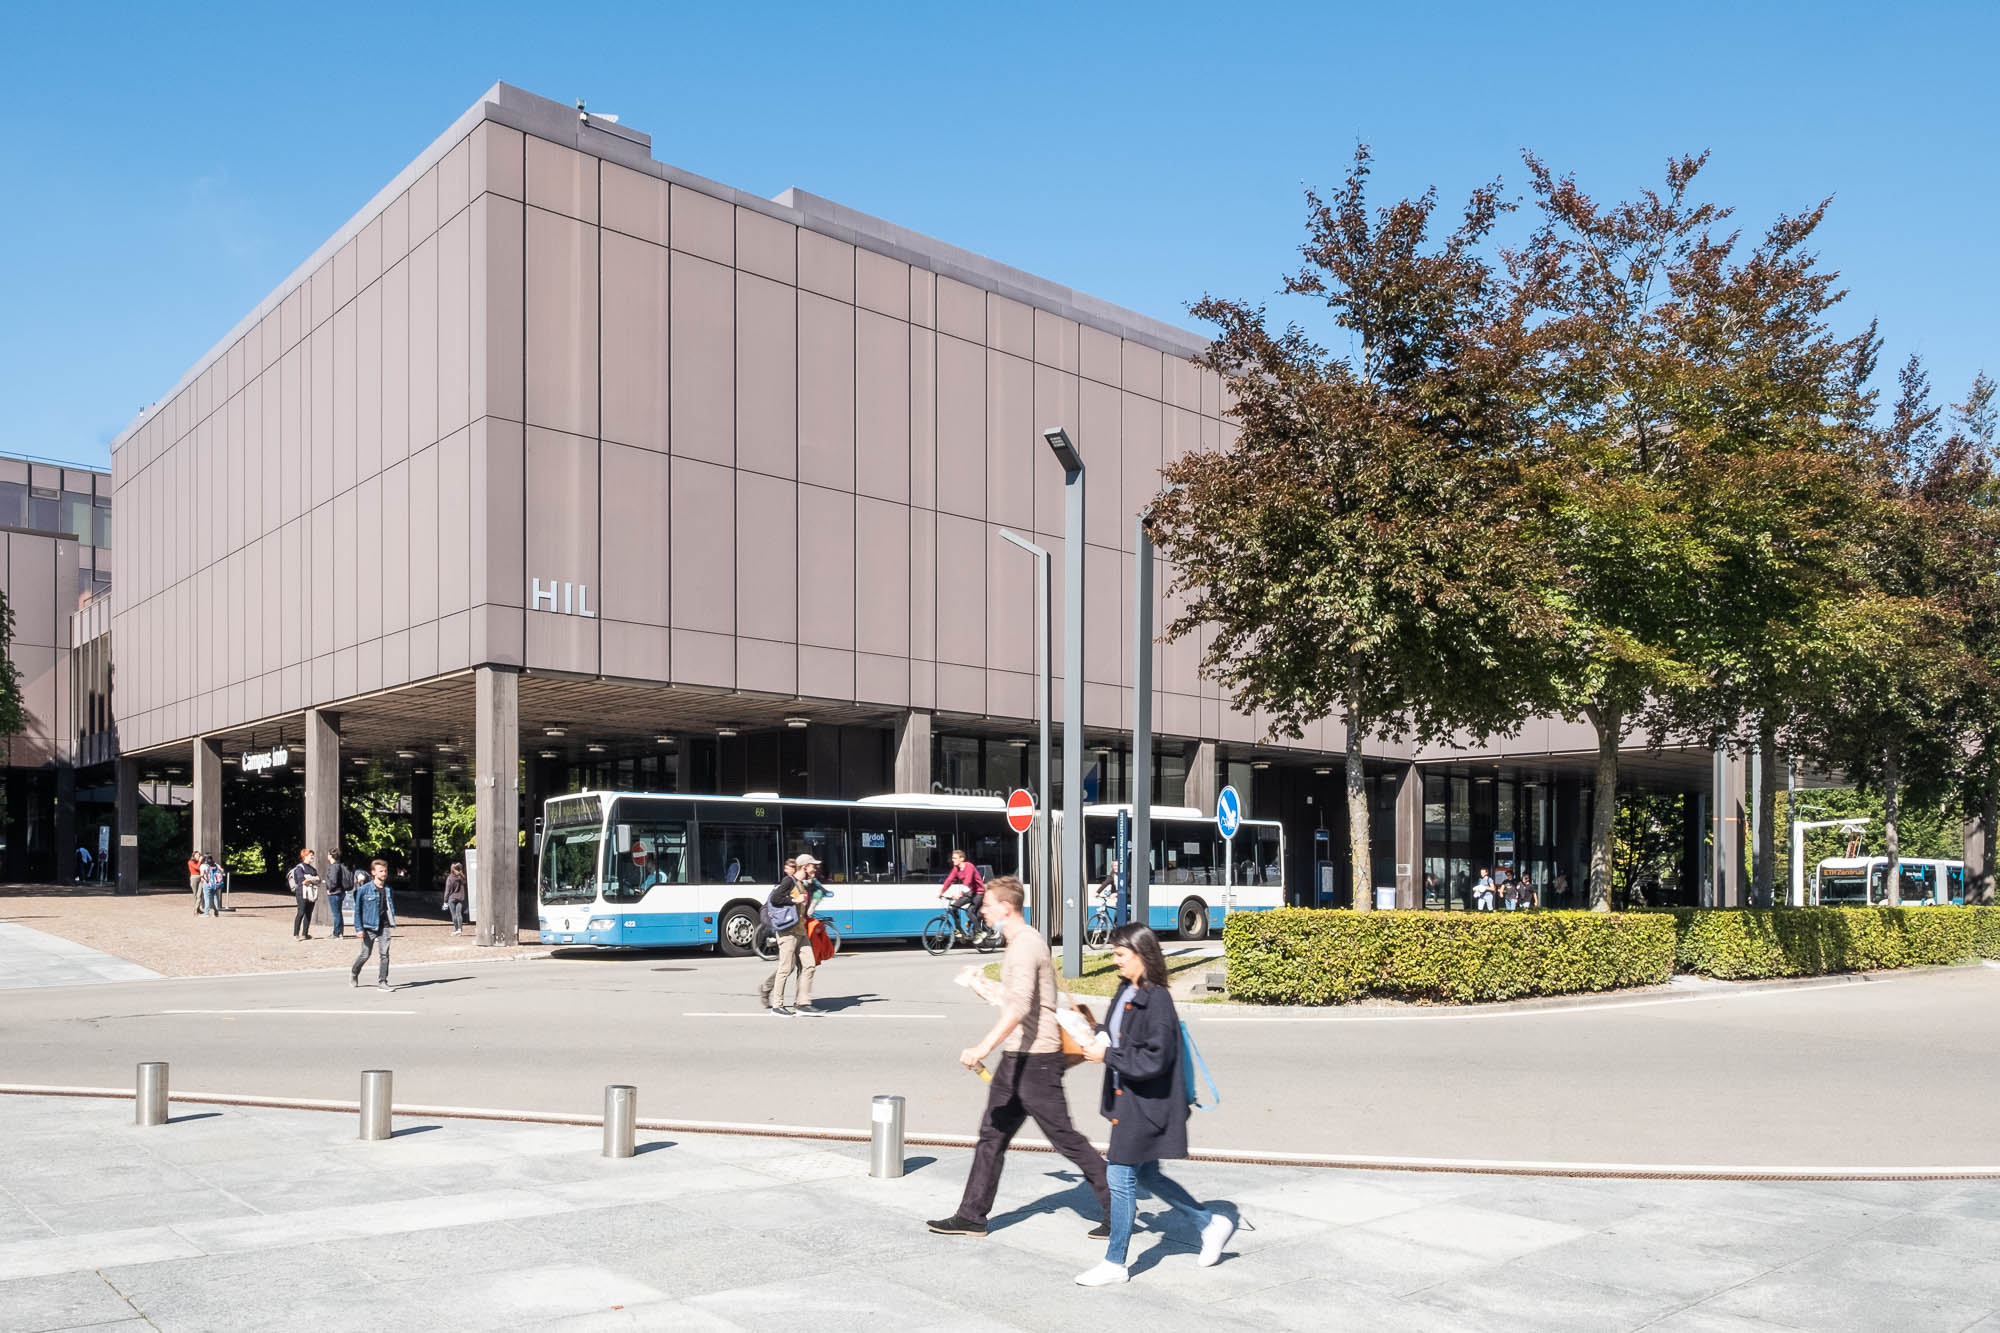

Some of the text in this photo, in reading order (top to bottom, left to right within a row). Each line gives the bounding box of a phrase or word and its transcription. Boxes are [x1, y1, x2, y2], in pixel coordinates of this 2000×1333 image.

[532, 578, 595, 617] HIL
[241, 745, 288, 774] Campus Info
[755, 807, 765, 817] 69
